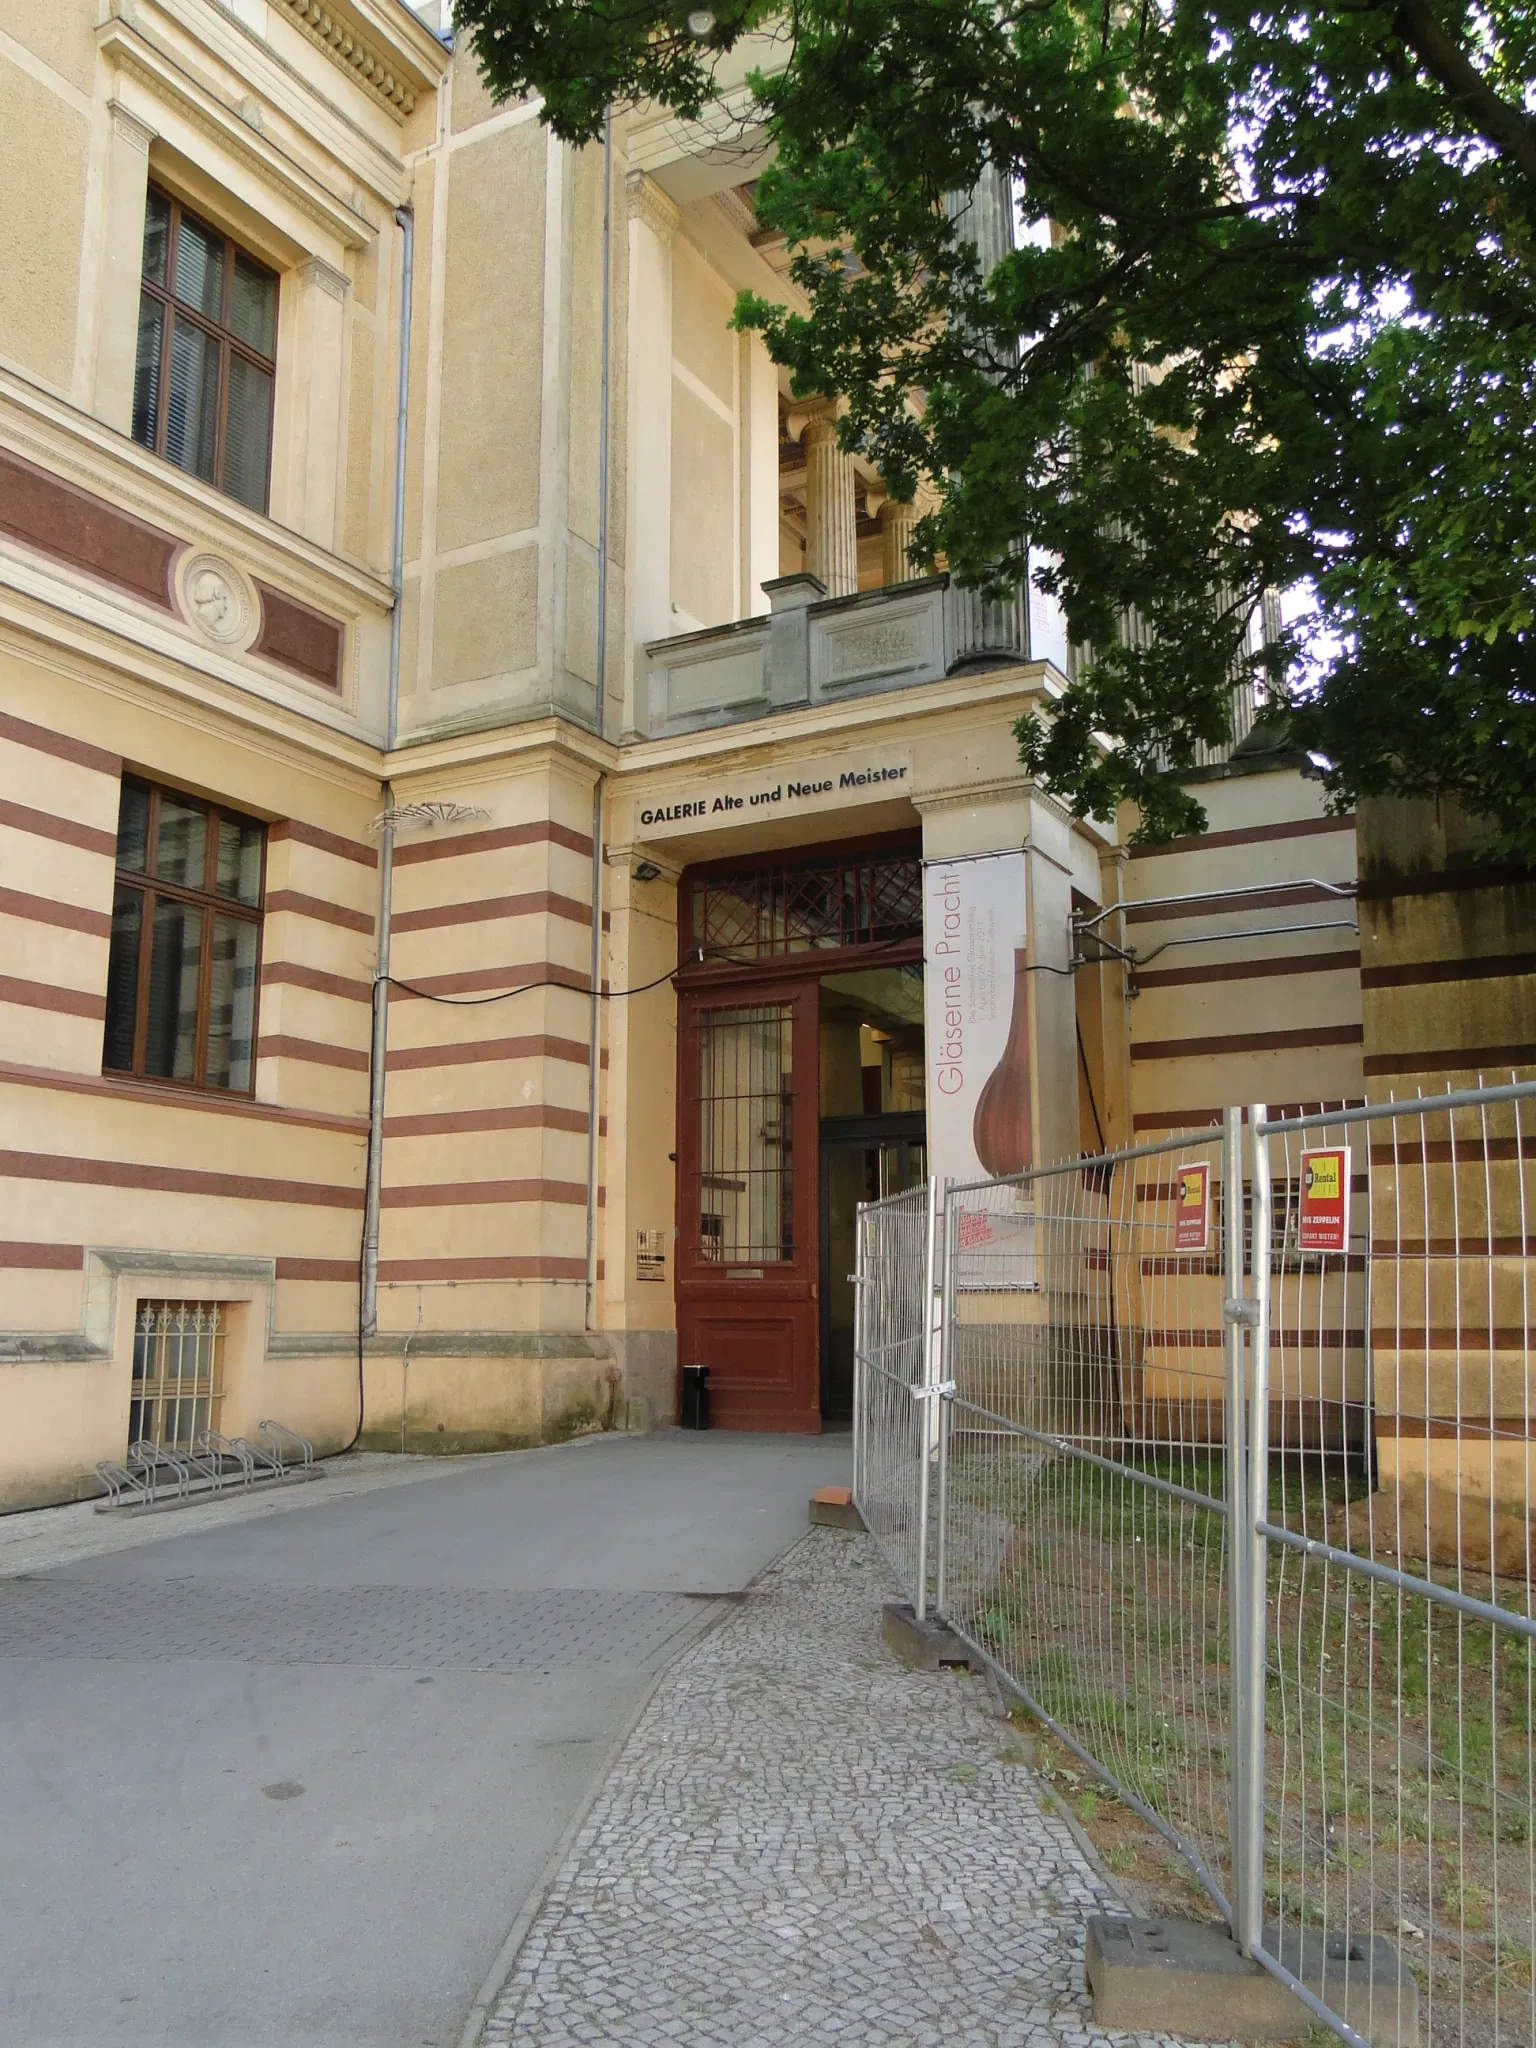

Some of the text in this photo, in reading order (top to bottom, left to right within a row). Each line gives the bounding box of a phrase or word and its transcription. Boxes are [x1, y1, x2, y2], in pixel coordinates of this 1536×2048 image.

[640, 766, 908, 825] GALERIE Alte und Neue Meister
[976, 920, 985, 943] 2011
[932, 873, 964, 1095] Gläserne Pracht
[1314, 1172, 1337, 1183] Rental
